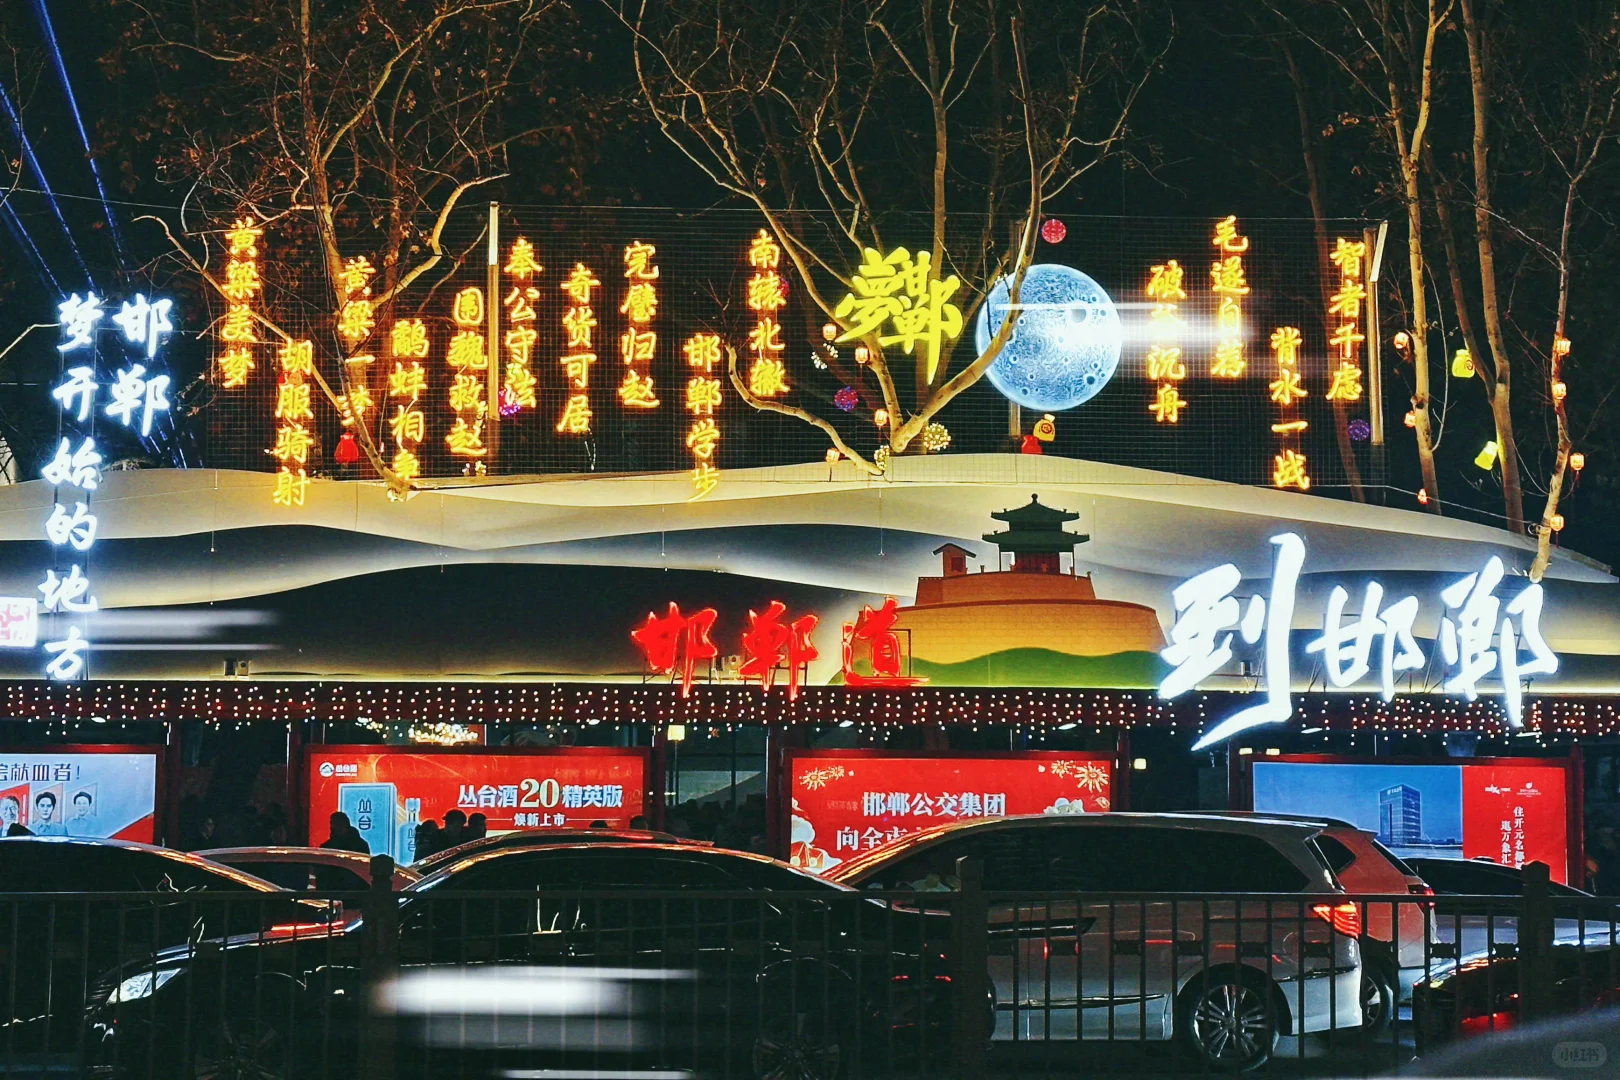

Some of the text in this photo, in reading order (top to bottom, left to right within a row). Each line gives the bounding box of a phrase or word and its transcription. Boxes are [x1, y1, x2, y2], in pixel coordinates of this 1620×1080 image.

[106, 292, 173, 437] 邯郸
[220, 216, 263, 388] 黄粱美梦
[337, 255, 376, 427] 黄粱一梦
[445, 287, 488, 456] 围魏救赵
[503, 237, 543, 408] 奉公守法
[556, 262, 600, 433] 奇货可居
[620, 240, 660, 408] 完璧归赵
[748, 228, 790, 397] 南辕北辙
[1211, 215, 1250, 379] 毛遂自荐
[1326, 236, 1366, 401] 智者千虑
[273, 340, 314, 506] 胡服骑射
[389, 319, 429, 481] 鹬蚌相争
[683, 332, 722, 502] 邯郸学步
[1269, 326, 1310, 491] 背水一战
[37, 291, 103, 679] 梦开始的地方
[457, 778, 623, 809] 丛台酒20精英版
[513, 813, 566, 827] 焕新上市
[862, 791, 1006, 817] 邯郸公交集团
